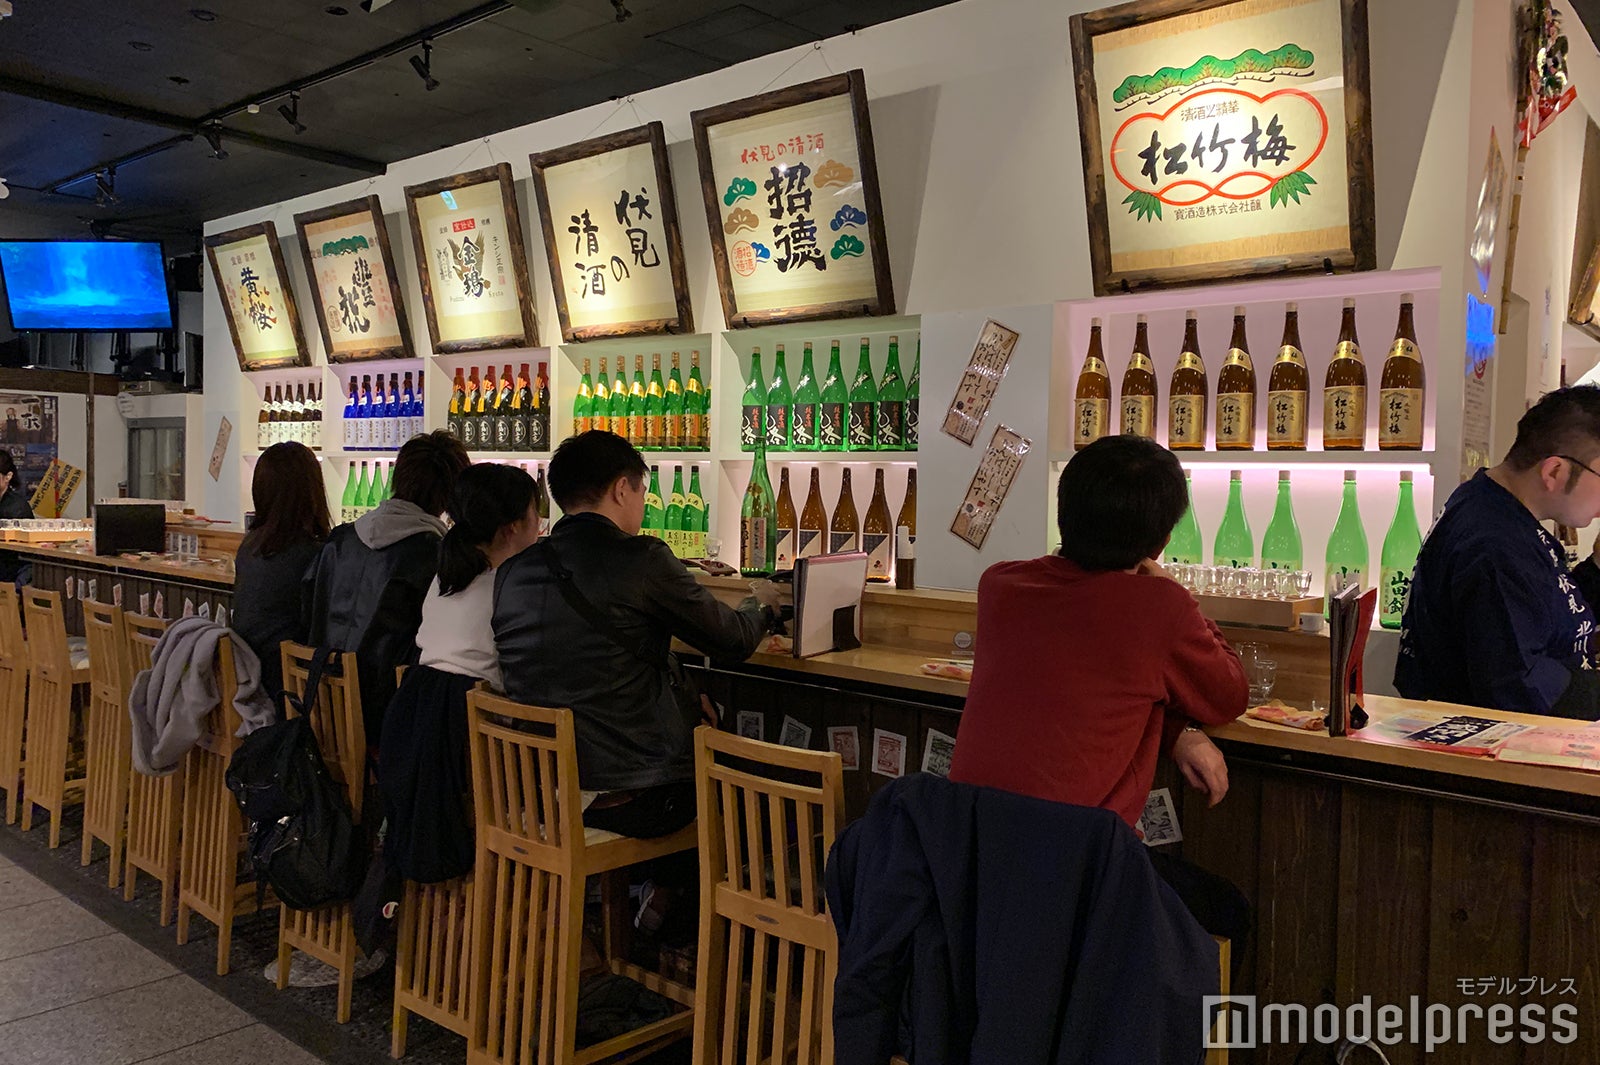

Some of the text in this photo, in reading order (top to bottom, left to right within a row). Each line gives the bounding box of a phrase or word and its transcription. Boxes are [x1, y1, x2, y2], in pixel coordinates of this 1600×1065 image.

[740, 132, 825, 164] 伏見の清酒
[1137, 113, 1297, 186] 松竹梅
[610, 187, 660, 282] 伏見の
[568, 208, 606, 299] 清酒
[1276, 400, 1288, 434] 松竹梅
[1334, 396, 1347, 431] 松竹梅
[1389, 398, 1402, 434] 松竹梅
